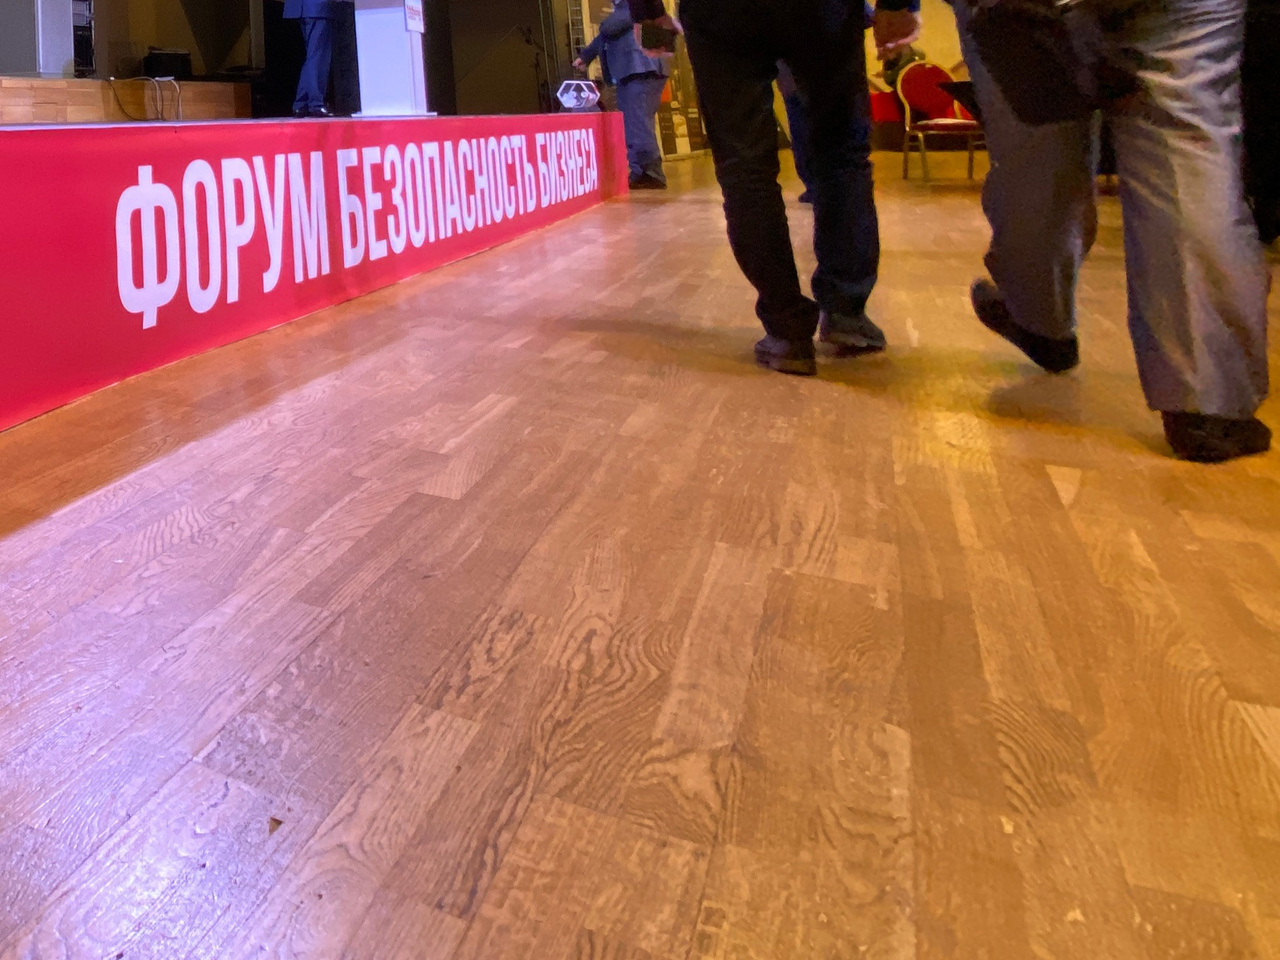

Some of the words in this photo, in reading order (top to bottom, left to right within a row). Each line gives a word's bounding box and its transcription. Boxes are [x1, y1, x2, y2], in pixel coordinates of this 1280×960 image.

[115, 150, 331, 330] ФОРУМ
[336, 134, 537, 269] БЕЗОПАСНОСТЬ
[535, 128, 598, 208] БИЗНЕСА
